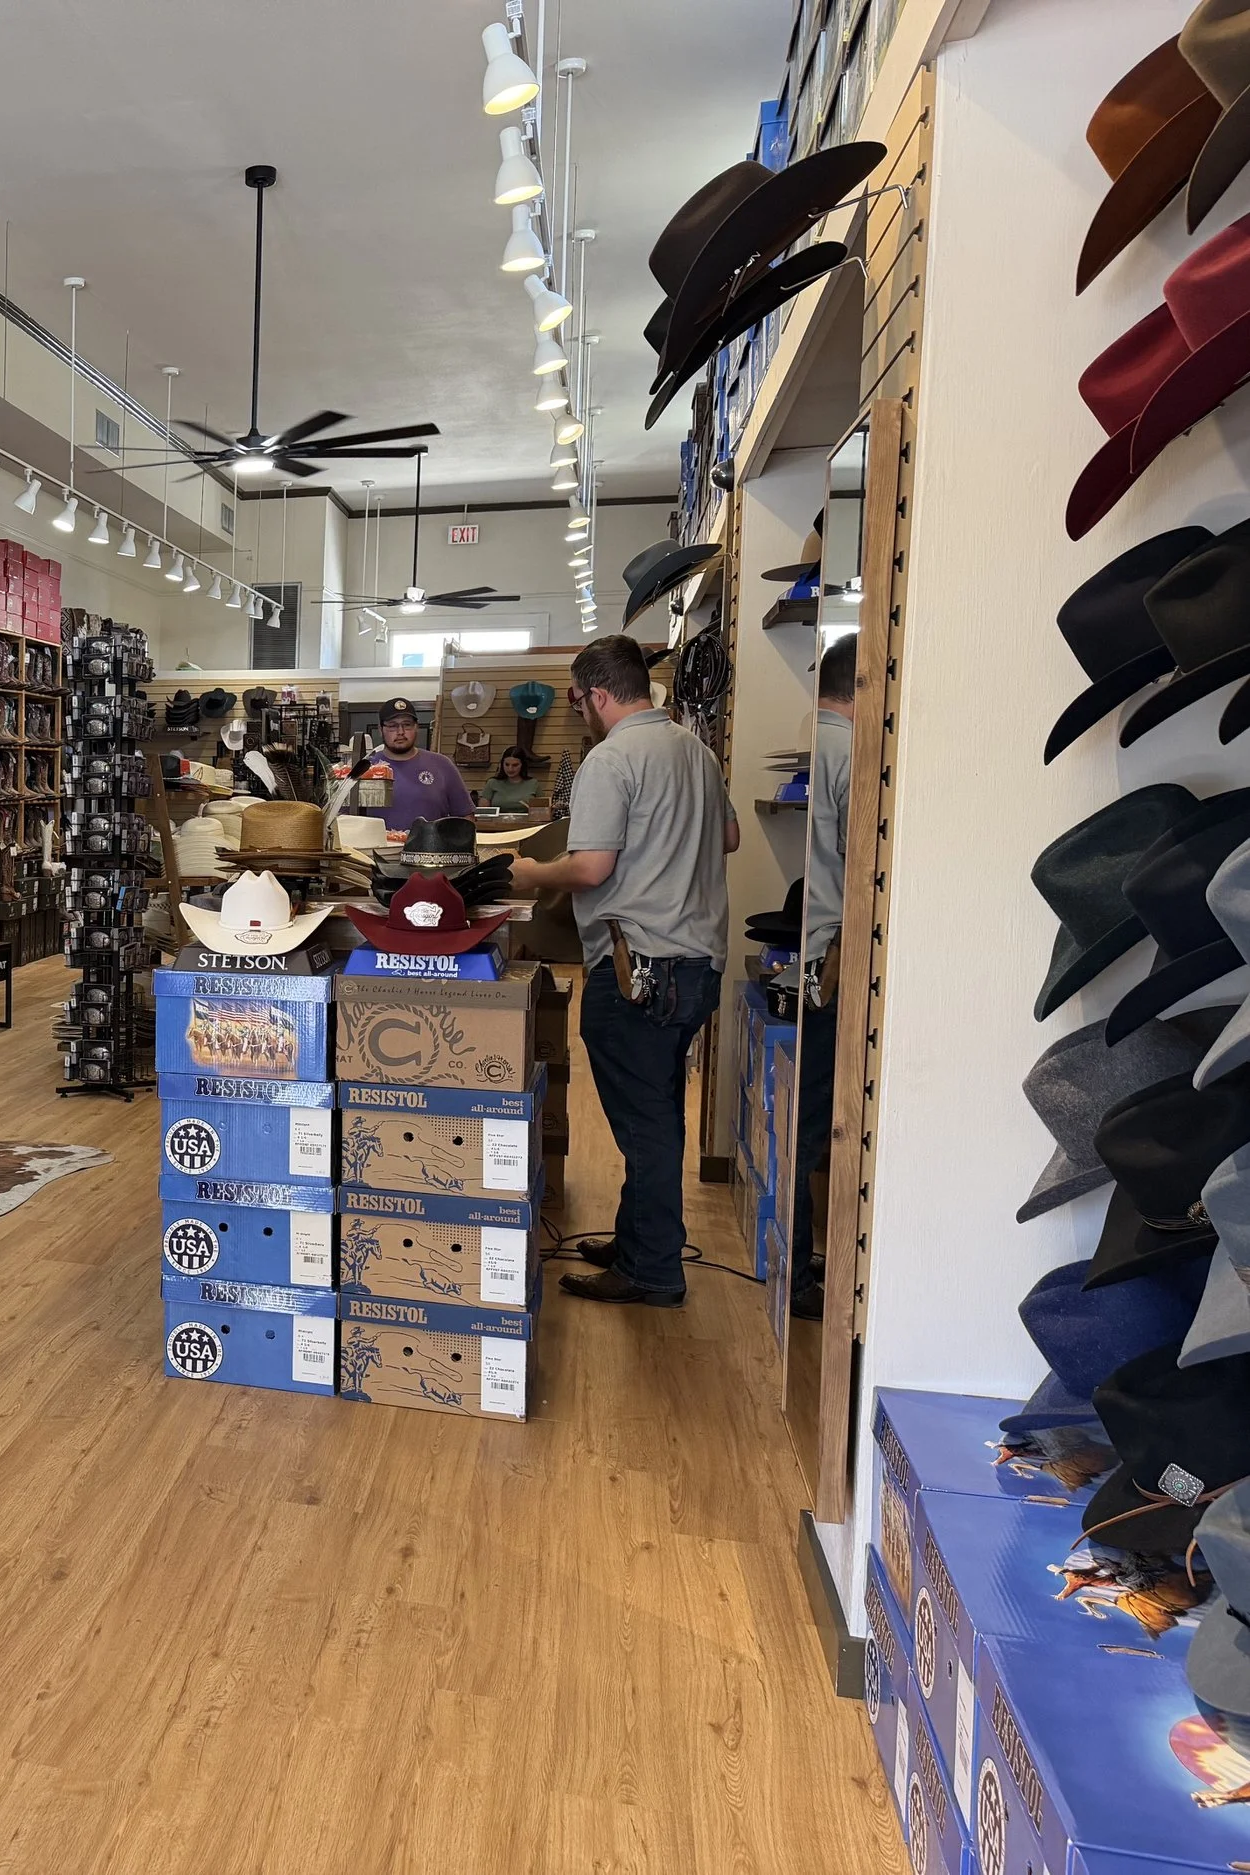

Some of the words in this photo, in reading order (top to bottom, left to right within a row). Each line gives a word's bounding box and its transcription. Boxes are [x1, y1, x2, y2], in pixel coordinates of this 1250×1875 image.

[451, 526, 477, 543] EXIT
[198, 953, 285, 970] STETSON
[375, 953, 459, 971] RESISTOL
[423, 970, 458, 978] all-around
[372, 985, 403, 995] Charlie
[440, 987, 468, 999] Legend
[448, 1060, 467, 1069] CO.
[348, 1088, 427, 1109] RESISTOL
[502, 1098, 524, 1107] best
[174, 1138, 212, 1156] USA
[346, 1194, 425, 1216] RESISTOL
[499, 1206, 521, 1215] best
[172, 1237, 210, 1256] USA
[350, 1300, 427, 1324] RESISTOL
[501, 1317, 523, 1327] best
[175, 1341, 215, 1360] USA
[880, 1413, 910, 1496] RESISTOL
[924, 1526, 959, 1639] RESISTOL
[864, 1577, 896, 1675] RESISTOL
[990, 1682, 1044, 1836] RESISTOL
[915, 1712, 947, 1839] RESISTOL
